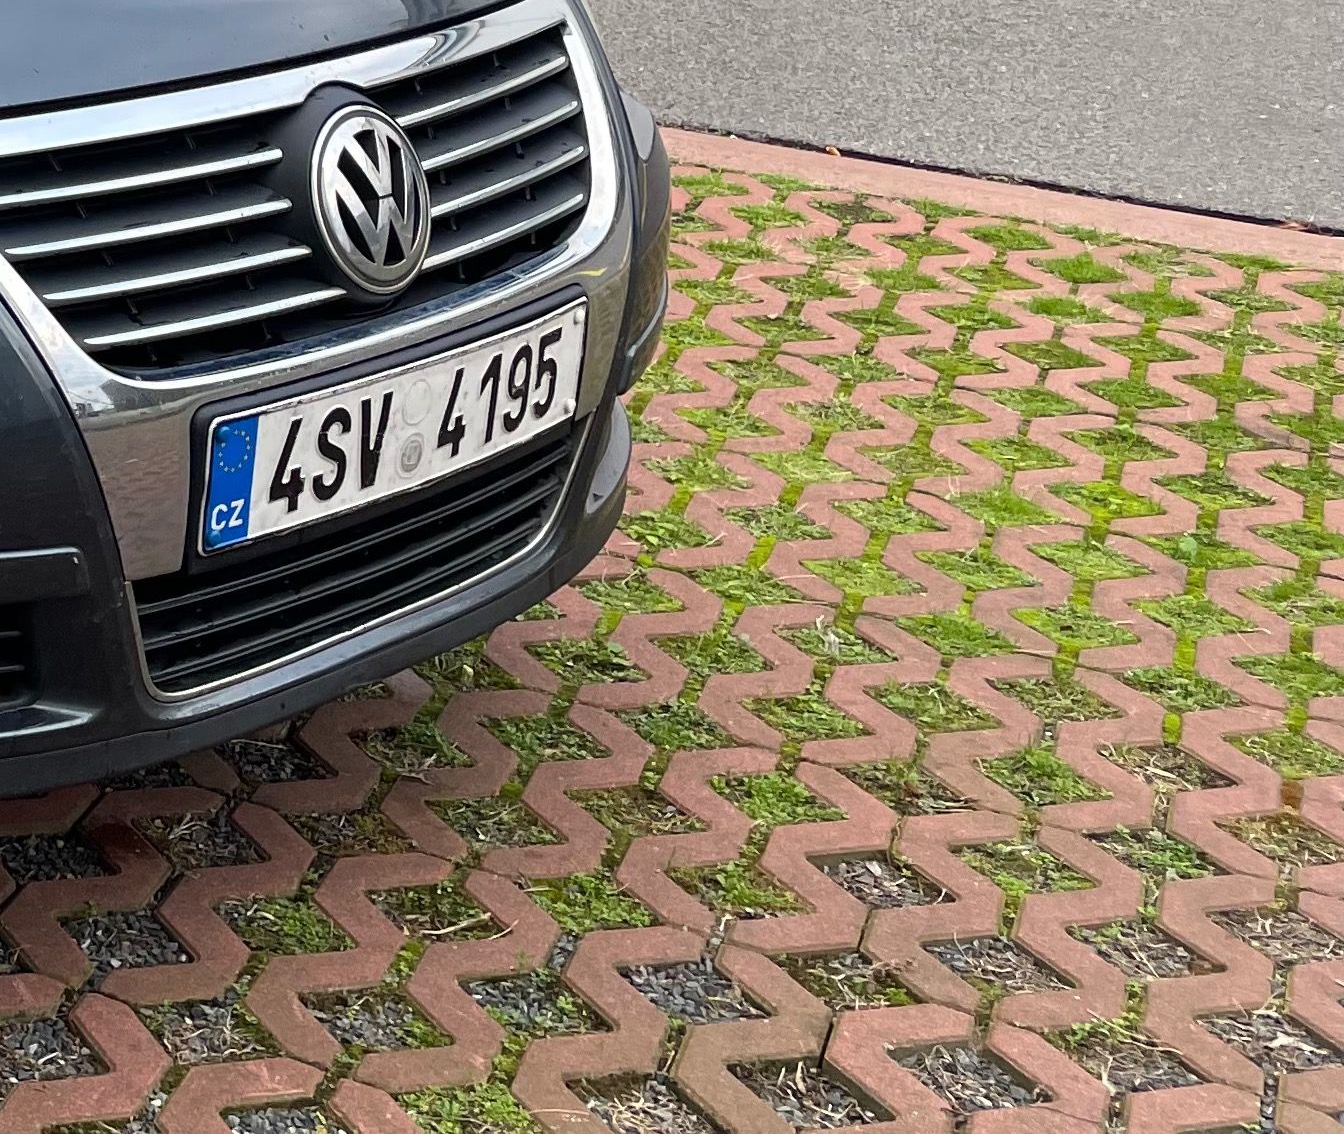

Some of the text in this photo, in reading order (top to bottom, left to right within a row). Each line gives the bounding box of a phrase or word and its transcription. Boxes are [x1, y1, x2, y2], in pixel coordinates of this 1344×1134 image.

[269, 326, 564, 513] 4SV 4195
[211, 498, 245, 531] CZ
